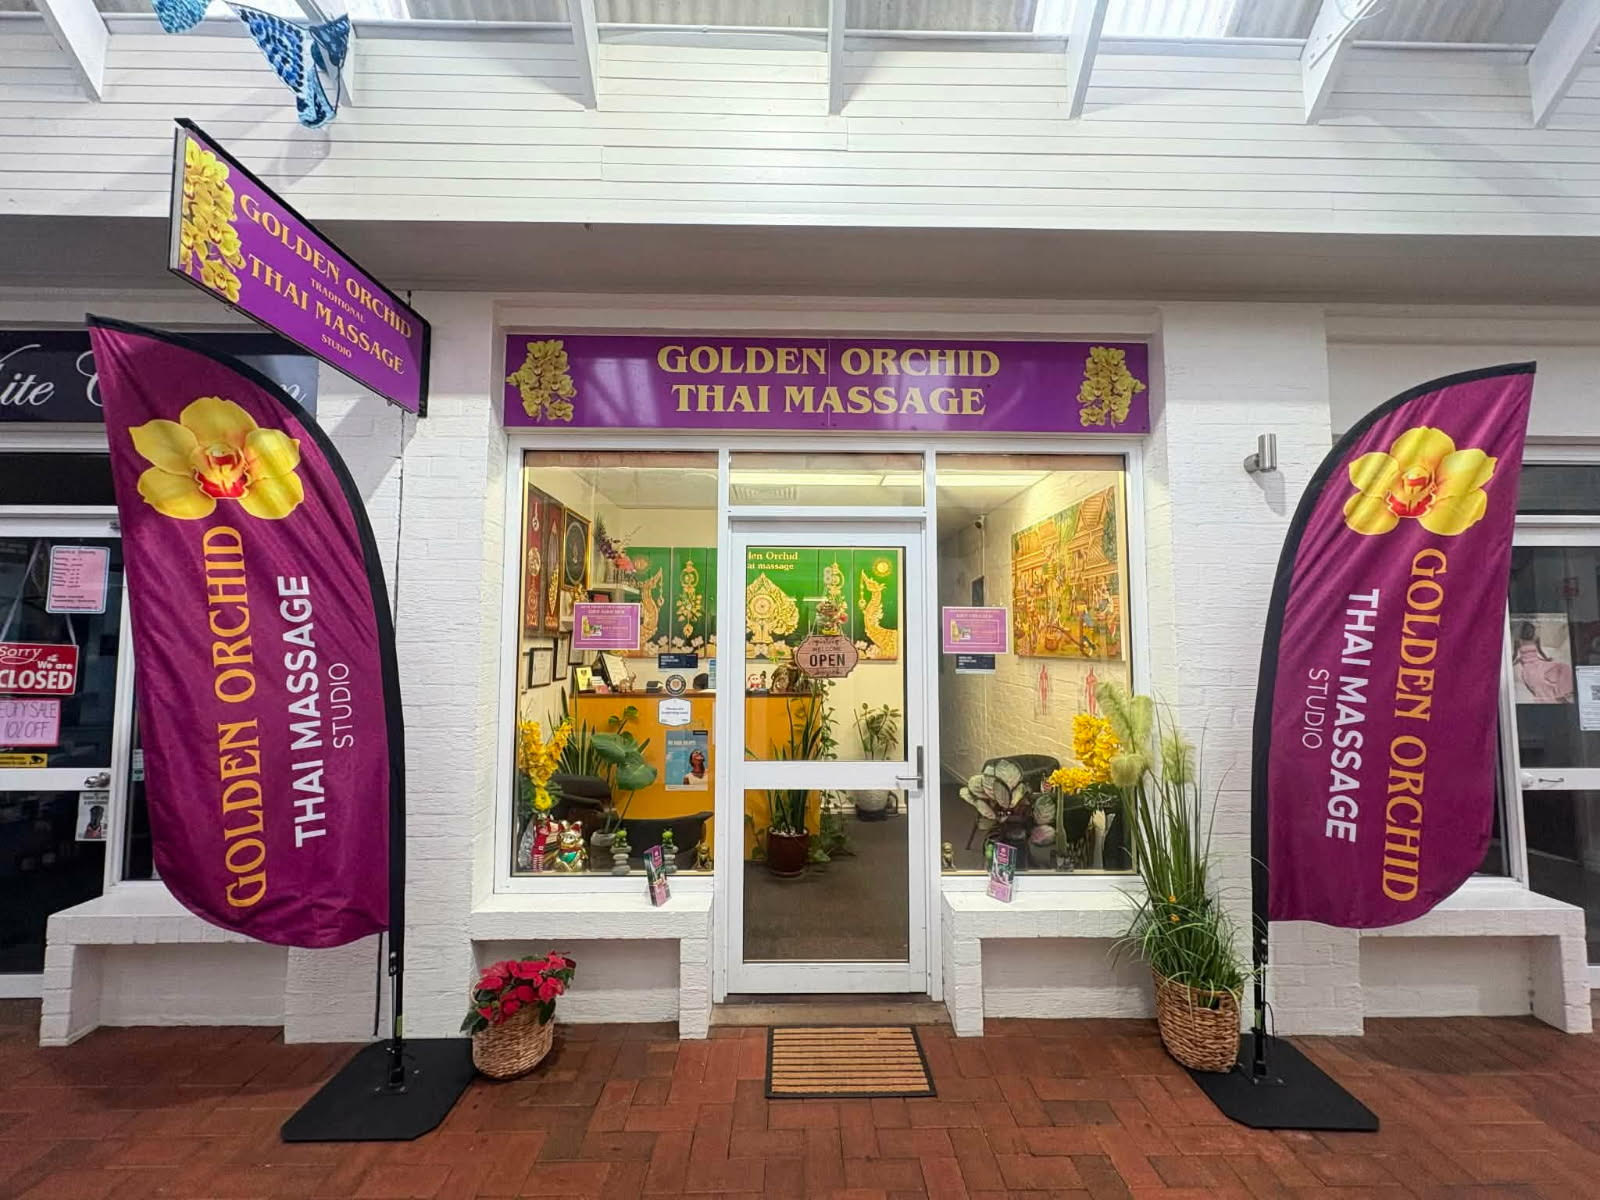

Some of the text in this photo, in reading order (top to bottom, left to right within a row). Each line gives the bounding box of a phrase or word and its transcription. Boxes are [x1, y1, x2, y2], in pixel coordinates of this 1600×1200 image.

[240, 194, 412, 338] GOLDEN ORCHID
[248, 253, 405, 374] THAI MASSAGE
[310, 278, 366, 323] TRADITIONAL
[321, 334, 352, 358] STUDIO
[657, 345, 1000, 377] GOLDEN ORCHID
[671, 384, 986, 415] THAI MASSAGE
[766, 551, 798, 560] Orchid
[0, 646, 42, 665] Sorry
[37, 660, 53, 669] We
[809, 653, 846, 667] OPEN
[0, 669, 73, 690] CLOSED
[203, 526, 267, 908] GOLDEN ORCHID
[277, 575, 327, 848] THAI MASSAGE
[328, 662, 354, 748] STUDIO
[1302, 668, 1330, 749] STUDIO
[1325, 588, 1380, 843] THAI MASSAGE
[1382, 548, 1448, 902] GOLDEN ORCHID
